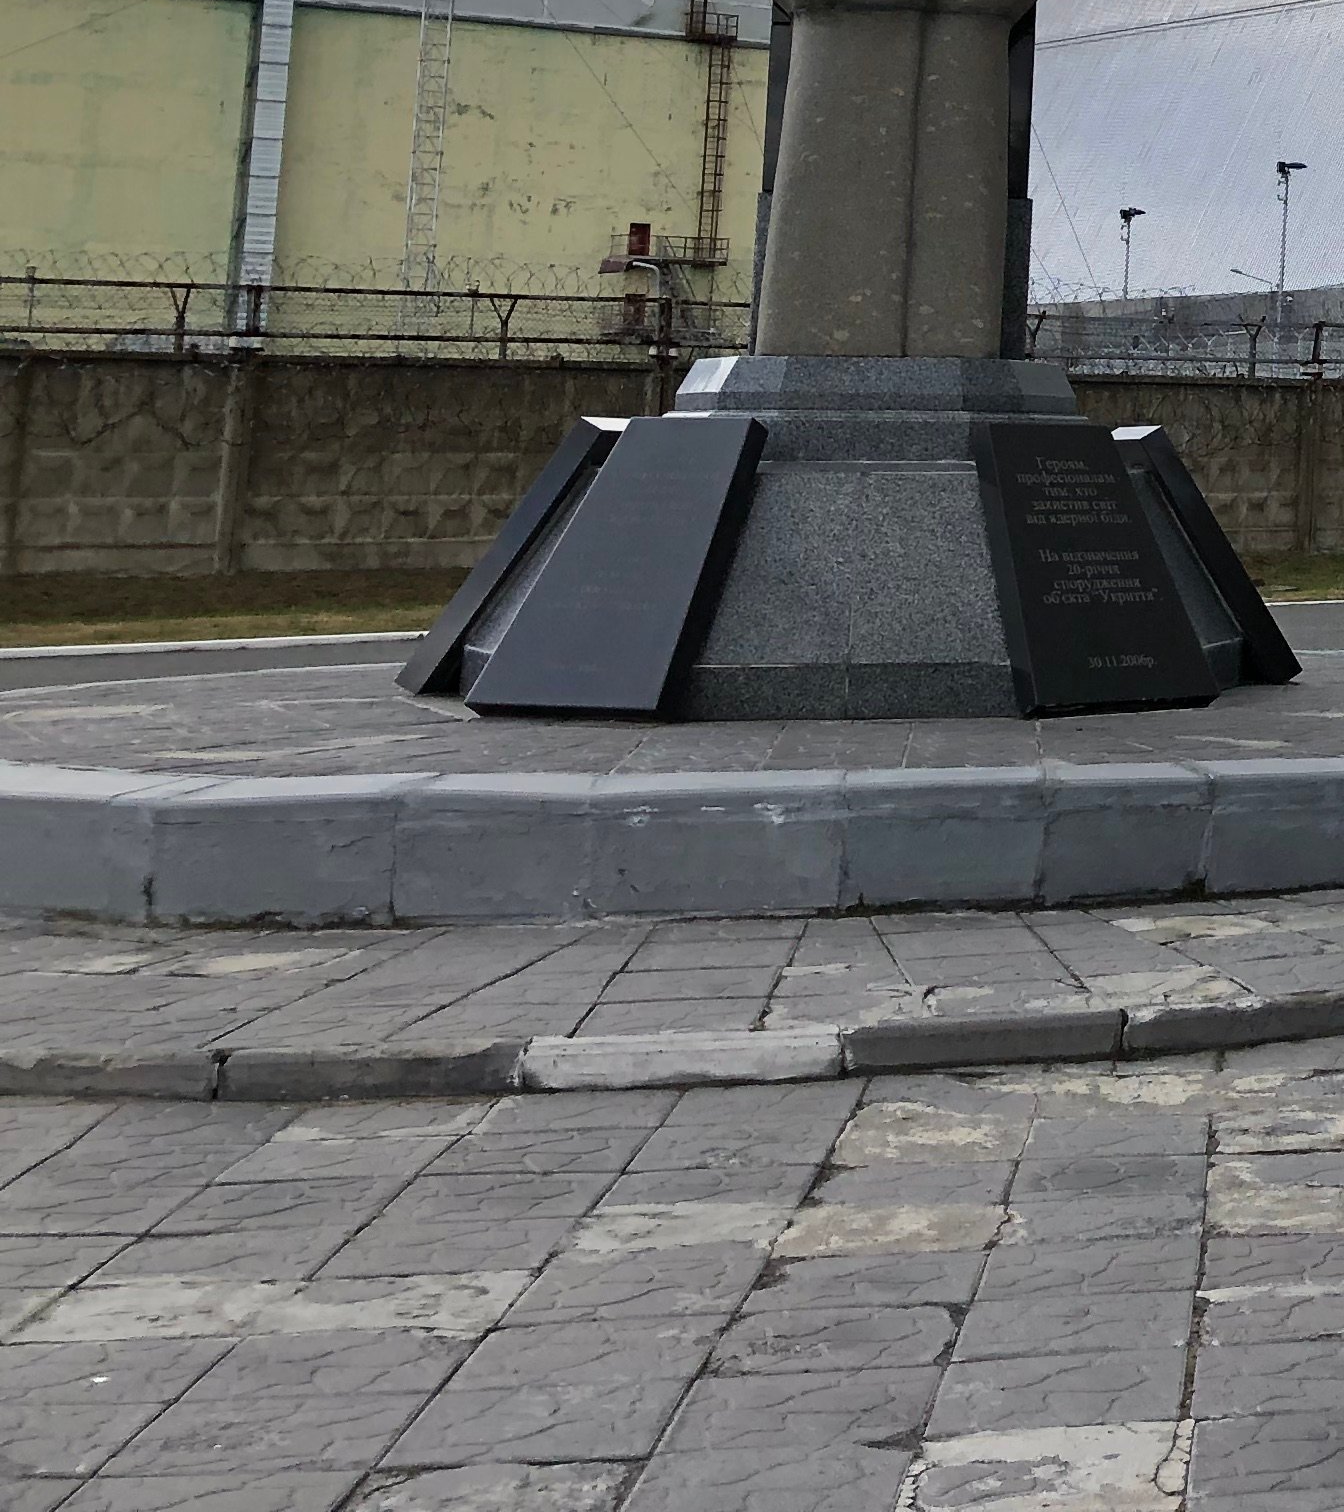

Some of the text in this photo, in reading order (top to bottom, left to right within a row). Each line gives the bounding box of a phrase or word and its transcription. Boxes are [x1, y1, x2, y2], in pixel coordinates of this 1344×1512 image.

[1075, 487, 1097, 497] хто
[1032, 497, 1117, 510] захистив світ
[1025, 513, 1046, 524] від
[1048, 511, 1098, 526] ядерної
[1038, 548, 1139, 562] На відзначення
[1066, 564, 1120, 578] 20-річчя
[1053, 577, 1141, 592] спорудження
